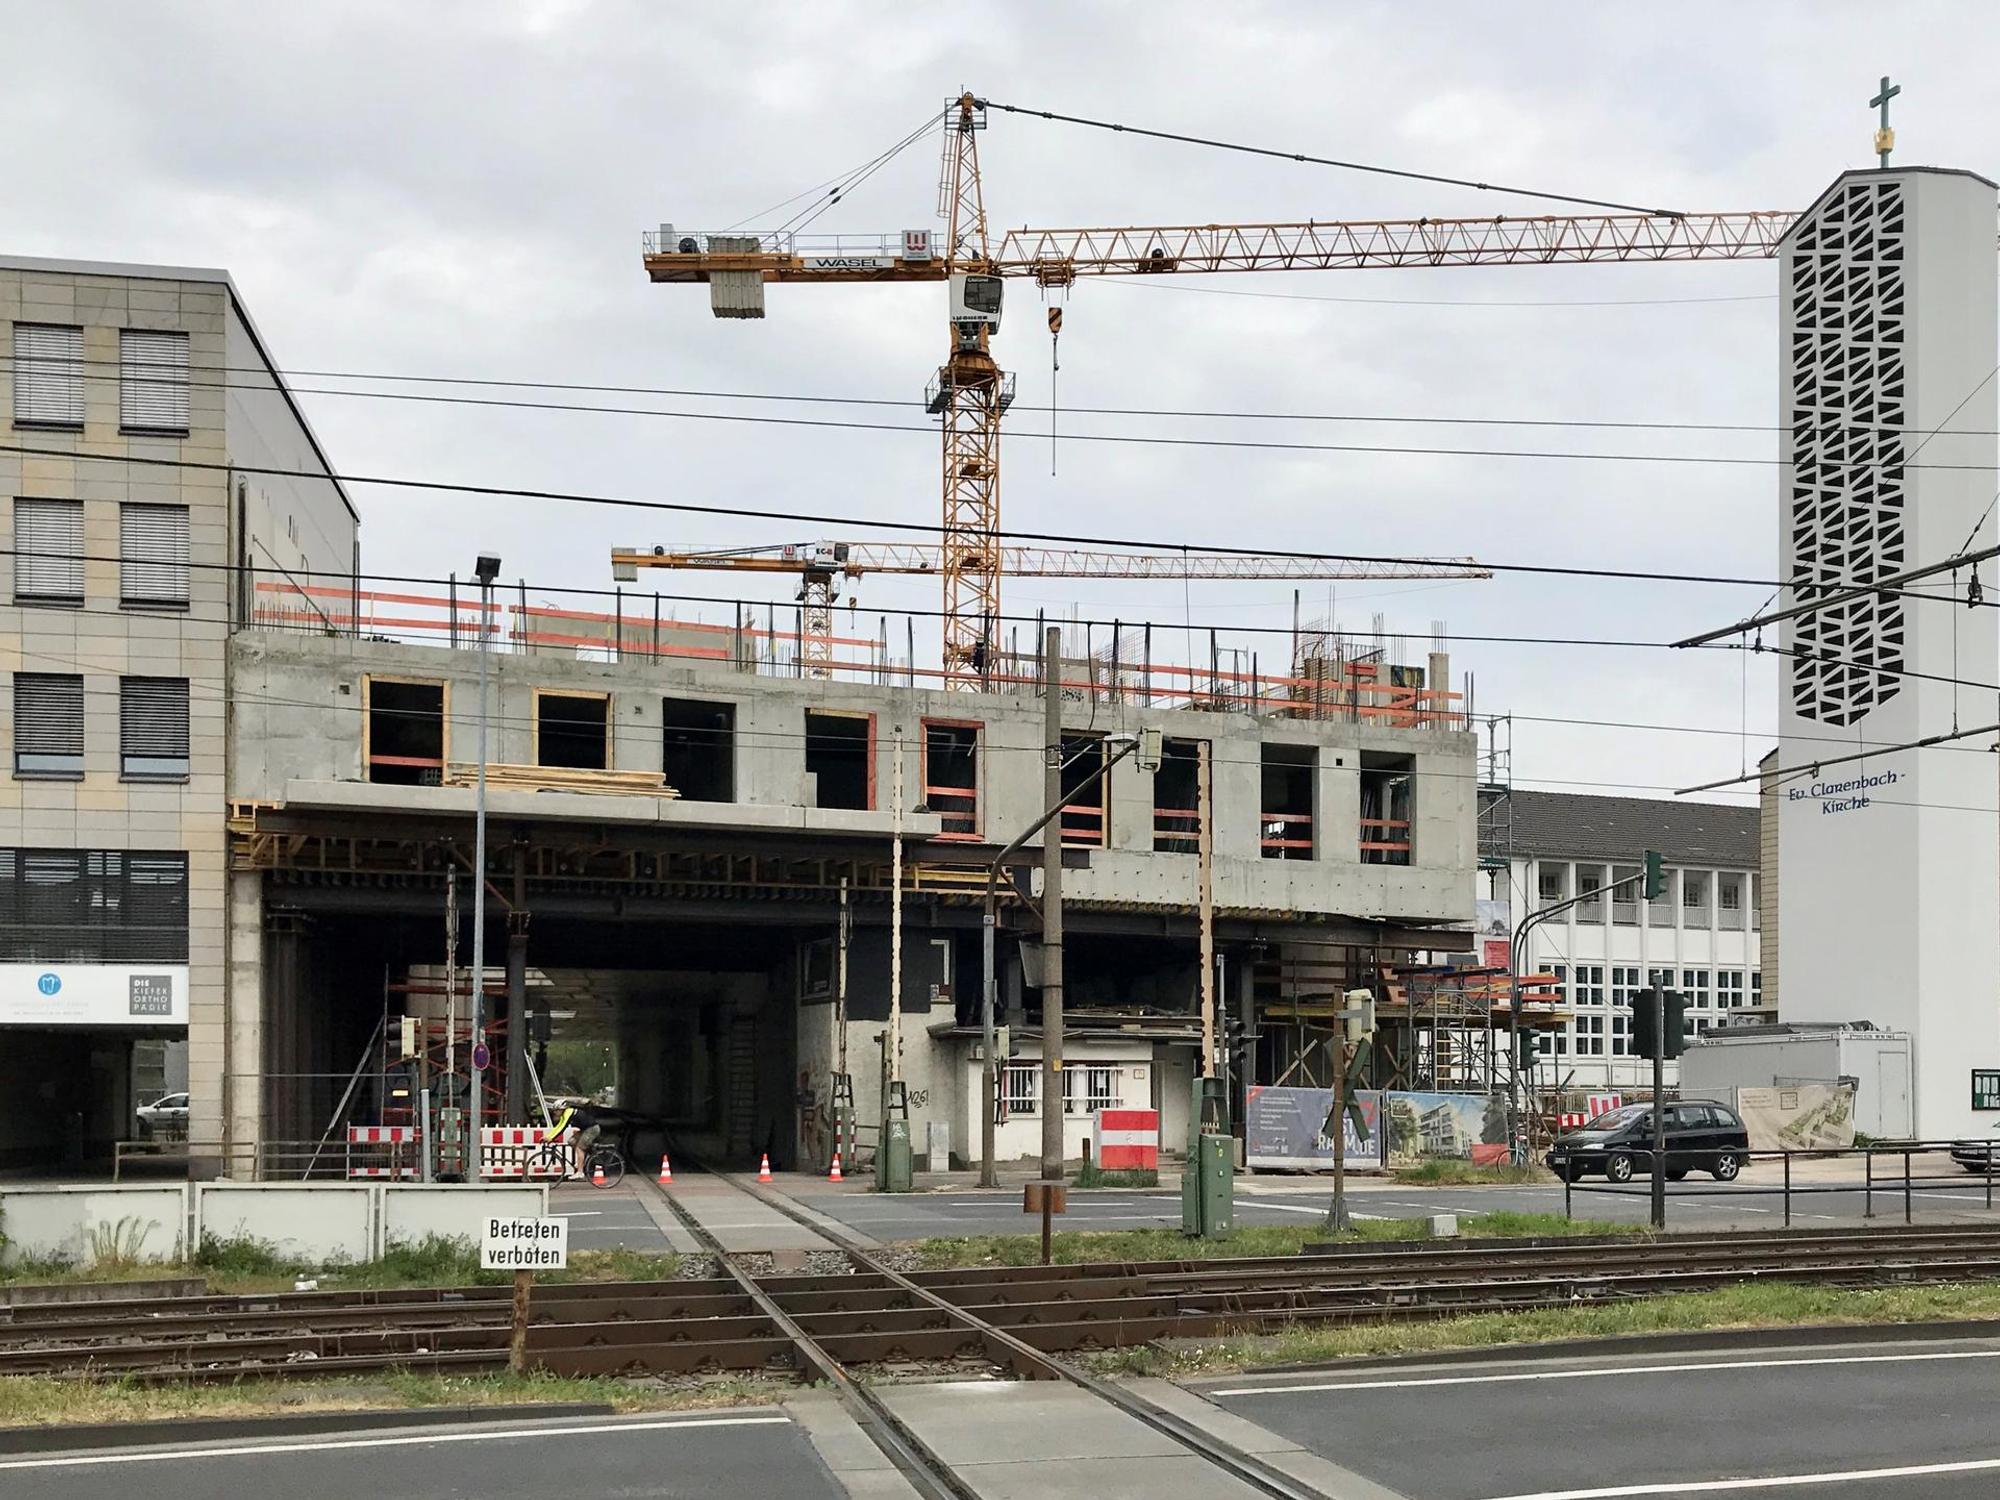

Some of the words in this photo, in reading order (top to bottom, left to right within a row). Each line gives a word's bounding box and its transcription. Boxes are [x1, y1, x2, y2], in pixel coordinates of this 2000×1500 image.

[816, 259, 883, 267] WASEL
[1789, 788, 1807, 801] Ev.
[1822, 796, 1870, 815] Kirche
[134, 979, 150, 987] DIE
[133, 995, 168, 1003] ORTHO
[490, 1219, 560, 1239] Betreten
[488, 1245, 560, 1264] verboten
